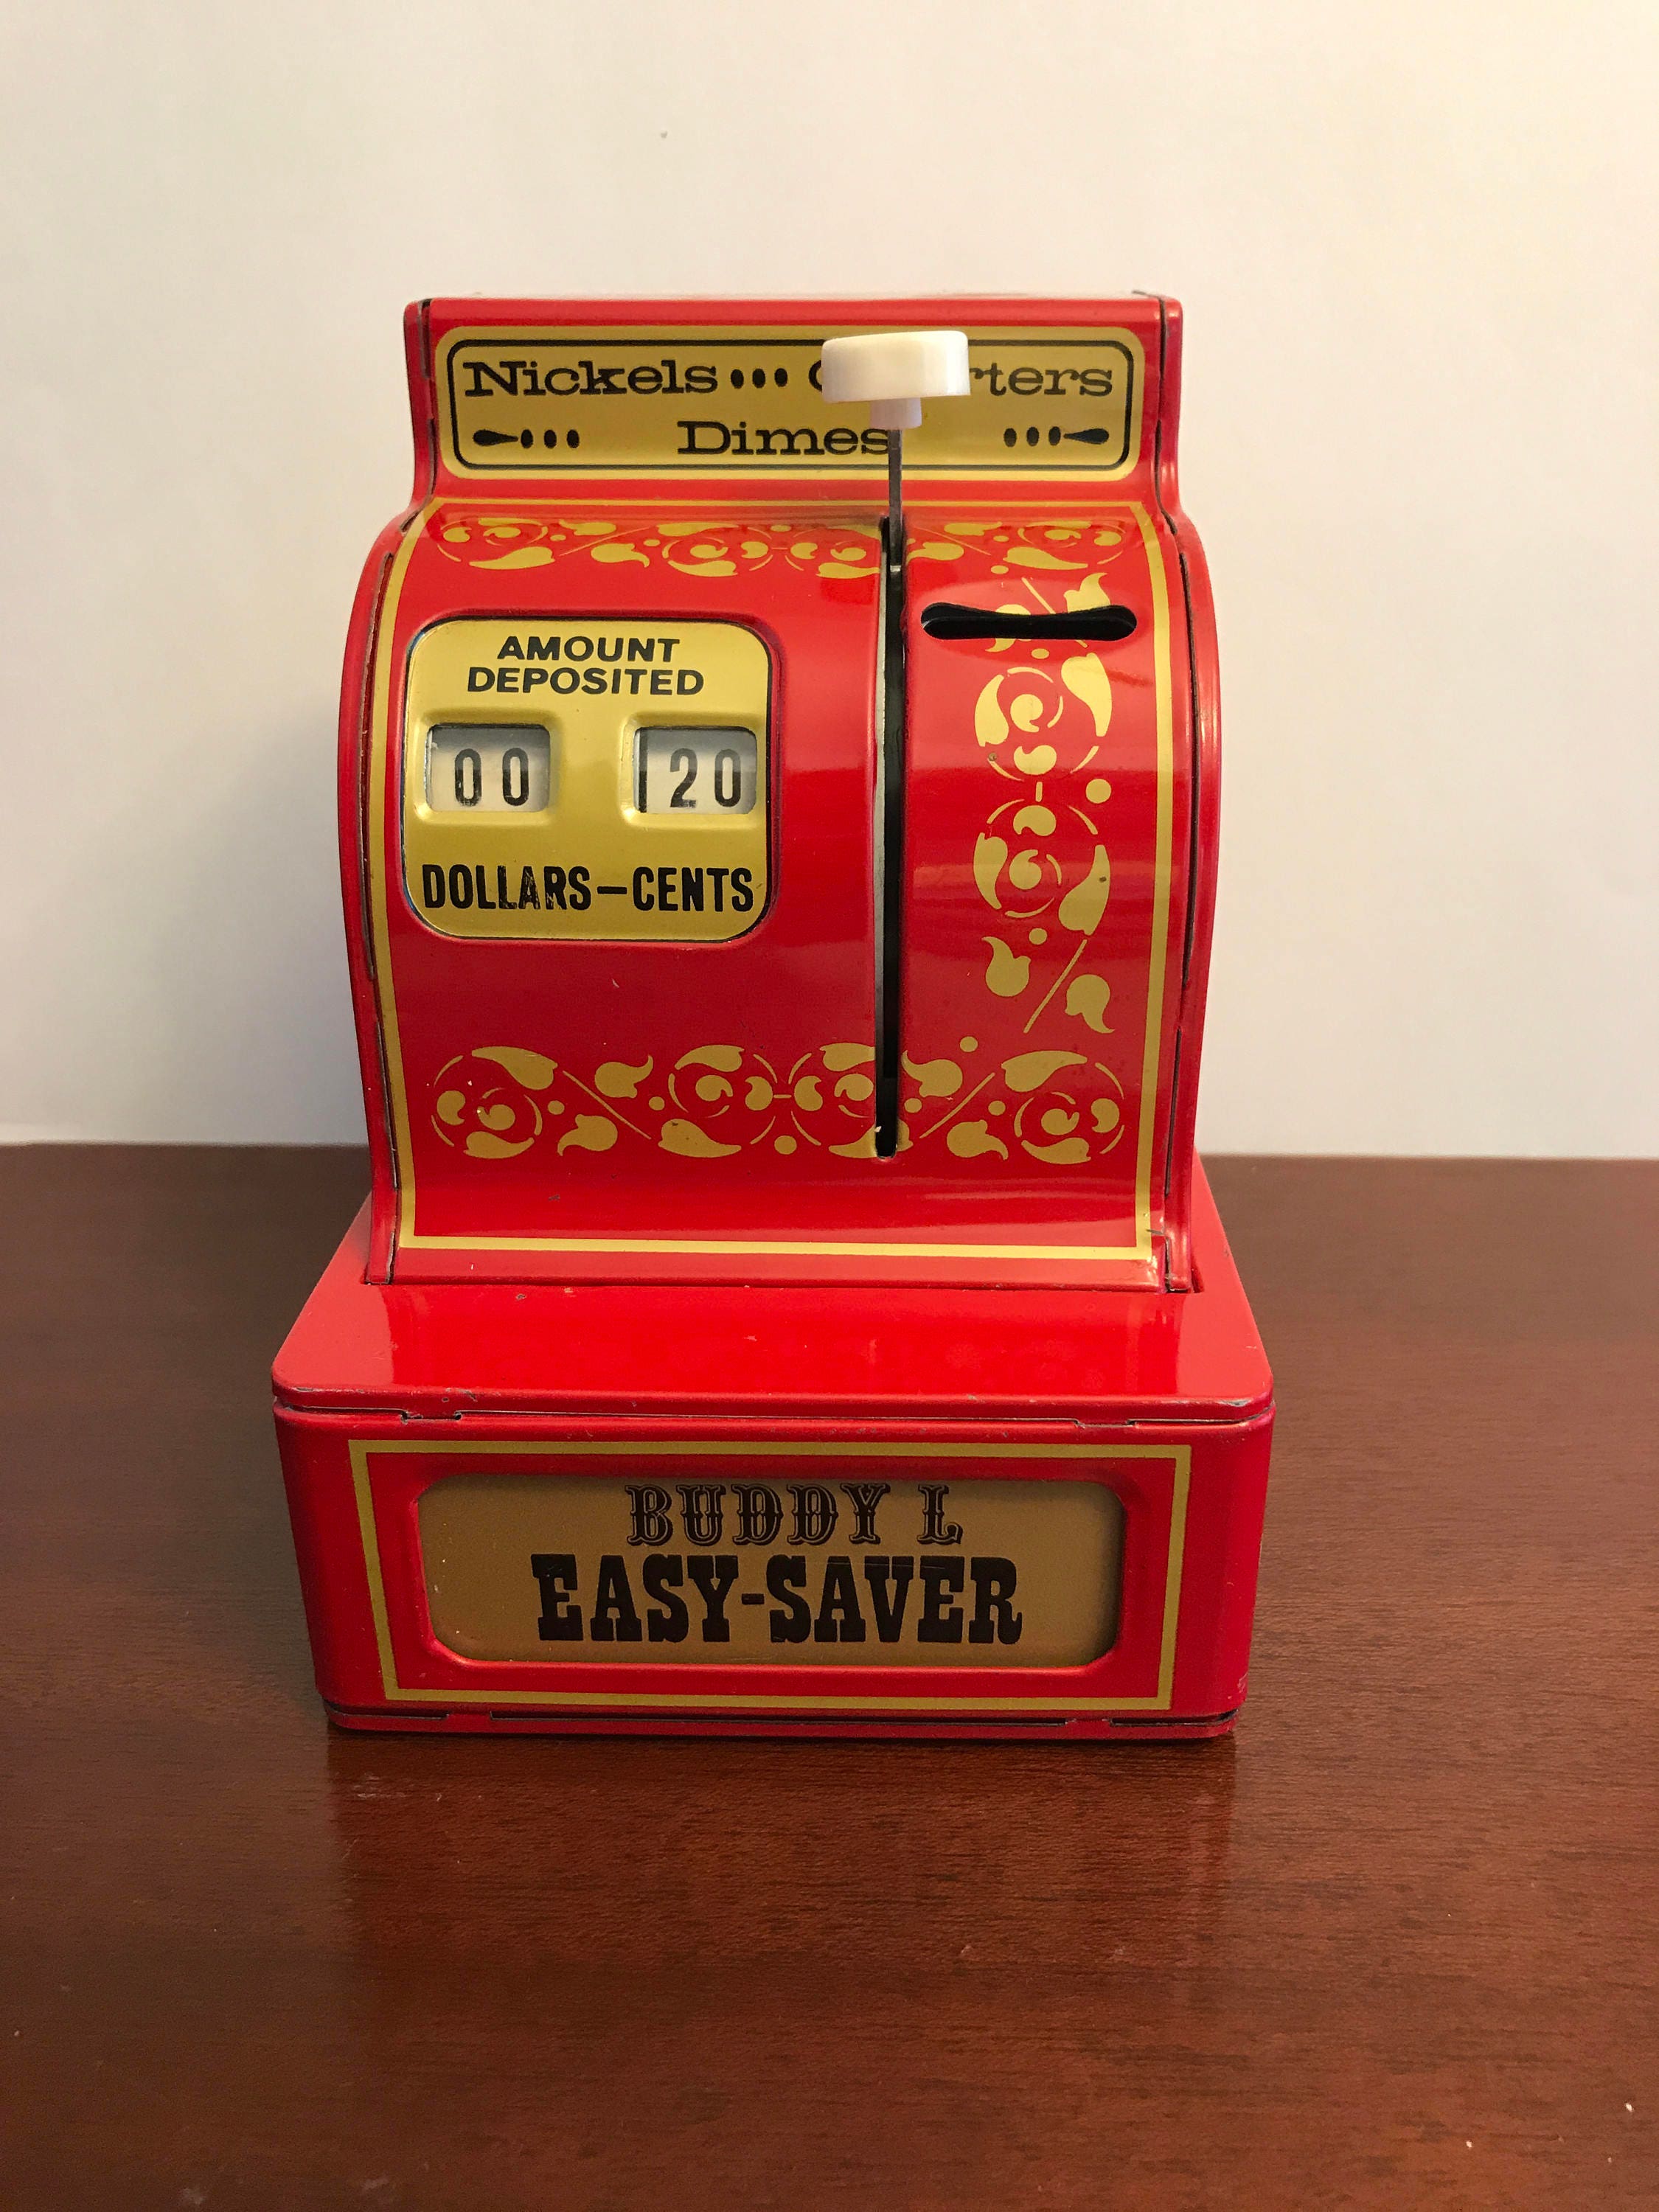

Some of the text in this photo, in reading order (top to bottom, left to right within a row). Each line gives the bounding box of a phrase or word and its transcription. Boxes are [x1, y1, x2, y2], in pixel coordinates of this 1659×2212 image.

[462, 359, 718, 397] Nickels
[678, 420, 890, 456] Dimes
[498, 636, 680, 662] AMOUNT
[467, 667, 704, 695] DEPOSITED
[454, 748, 529, 806] 00
[625, 1484, 962, 1545] BUDDY L
[530, 1554, 1023, 1645] EASY-SAVER
